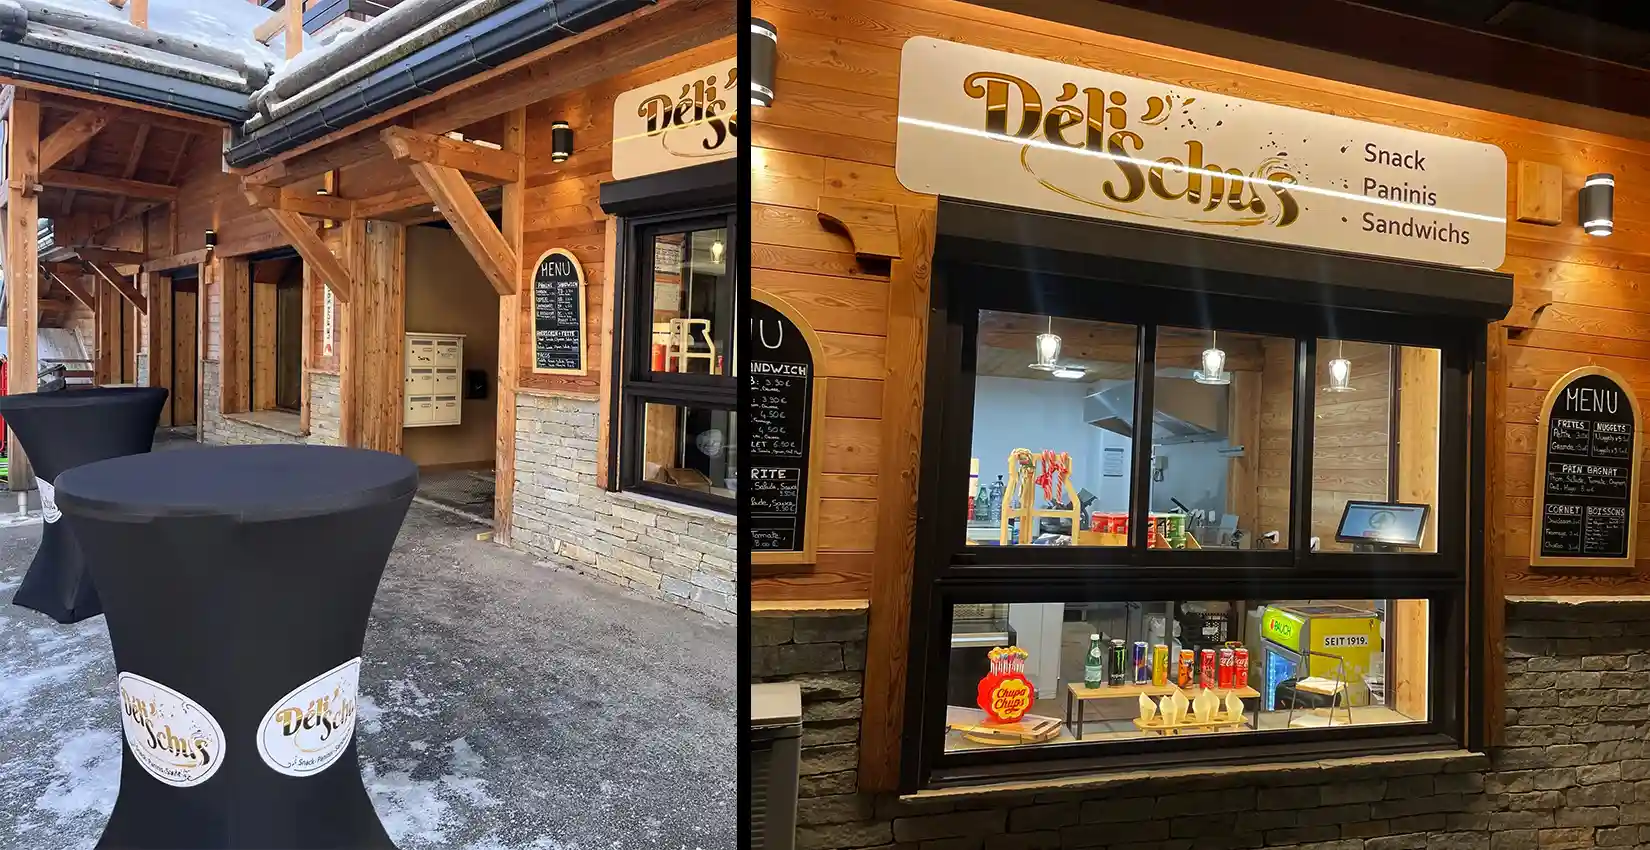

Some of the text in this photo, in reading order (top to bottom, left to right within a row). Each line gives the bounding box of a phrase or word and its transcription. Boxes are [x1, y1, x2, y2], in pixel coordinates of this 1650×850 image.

[1364, 142, 1426, 171] Snack
[1363, 177, 1437, 206] Paninis
[1361, 211, 1470, 245] Sandwichs
[541, 261, 571, 277] MENU
[1566, 387, 1618, 414] MENU
[1557, 419, 1585, 430] FRITES
[1597, 422, 1626, 433] NUGGETS
[1562, 464, 1583, 474] PAIN
[1548, 505, 1580, 514] CORNET
[1587, 506, 1625, 517] BOISSONS
[1325, 636, 1368, 646] SEIT 1919.
[997, 688, 1027, 700] Chupa
[994, 698, 1025, 710] Chups
